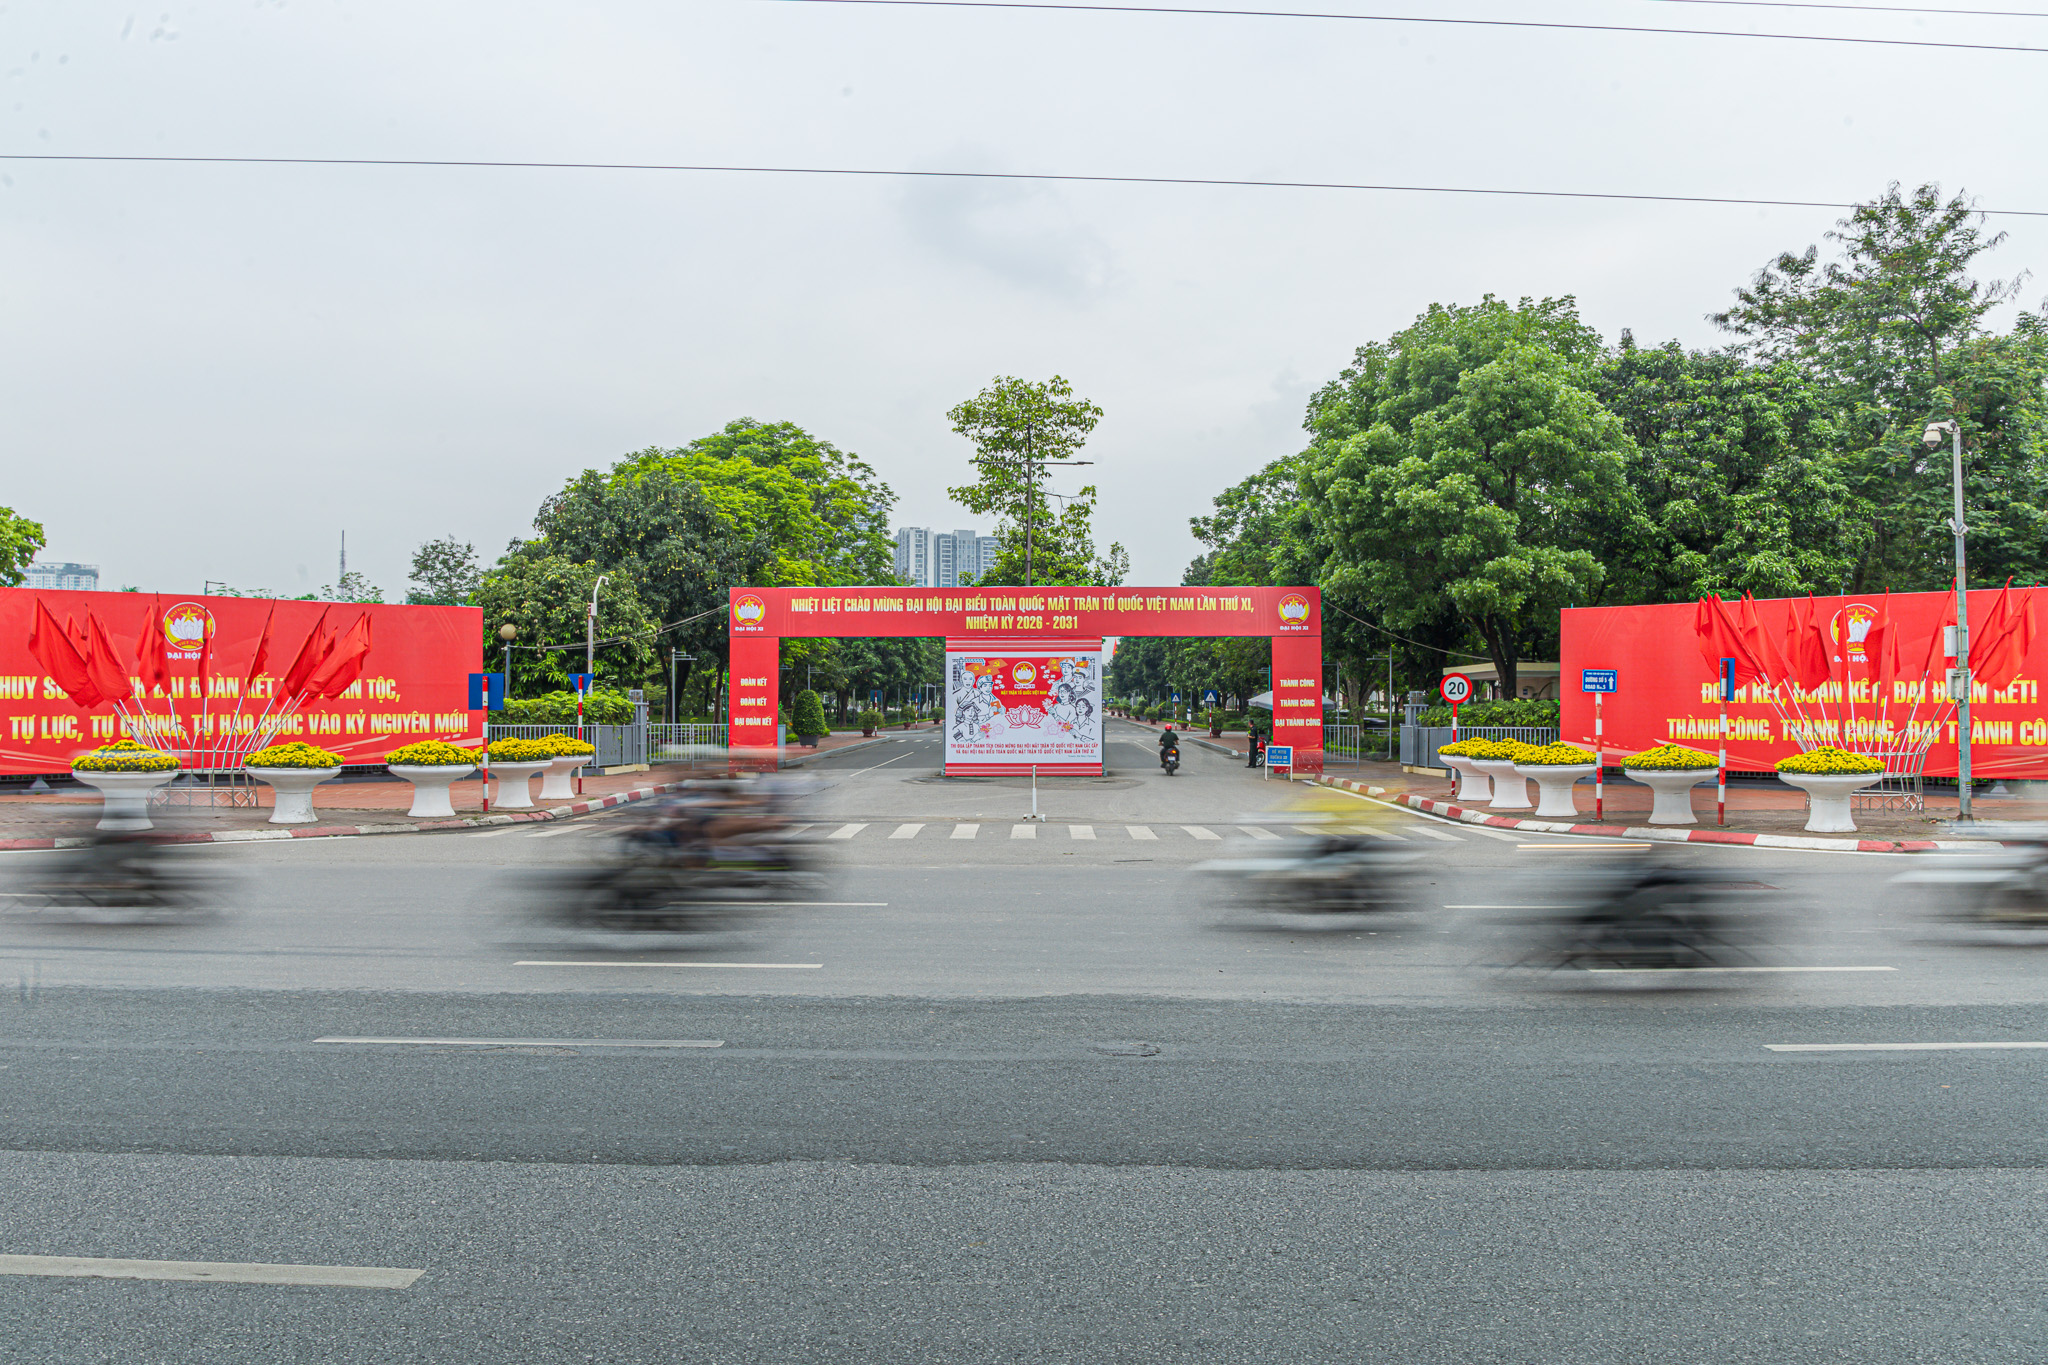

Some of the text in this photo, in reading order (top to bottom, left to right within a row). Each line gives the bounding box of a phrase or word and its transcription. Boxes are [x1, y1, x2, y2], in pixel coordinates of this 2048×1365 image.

[791, 593, 1254, 614] NHIỆT LIỆT CHÀO MỪNG ĐẠI HỘI ĐẠI BIỂU TOÀN QUỐC MẶT TRẬN TỔ QUỐC VIỆT NAM LẦN THỨ XI,
[966, 614, 998, 632] NHIỆM
[1001, 614, 1014, 629] KỲ
[1017, 616, 1043, 629] 2026
[1053, 616, 1078, 629] 2031
[166, 652, 182, 660] ĐẠI
[184, 651, 201, 660] HỘI
[1853, 654, 1868, 662] HỘ
[740, 676, 767, 686] ĐOÀN KẾT
[1280, 678, 1315, 687] THÀNH CÔNG
[0, 676, 38, 699] HUY
[366, 676, 401, 703] TỘC,
[1448, 682, 1465, 695] 20
[1893, 681, 1926, 707] ĐẠI
[740, 696, 767, 706] ĐOÀN KẾT
[1280, 698, 1315, 707] THÀNH CÔNG
[9, 714, 36, 744] TỰ
[41, 714, 83, 743] LỰC,
[90, 714, 115, 743] TỰ
[191, 713, 215, 741] TỰ
[220, 710, 254, 735] HÀO
[308, 710, 341, 735] VÀO
[346, 709, 366, 734] KỶ
[371, 710, 430, 734] NGUYÊN
[435, 709, 468, 733] MỚI!
[734, 716, 772, 727] ĐẠI ĐOÀN KẾT
[1275, 717, 1321, 727] ĐẠI THÀNH CÔNG
[1667, 715, 1719, 740] THÀNH
[1726, 716, 1775, 744] CÔNG,
[1946, 716, 2012, 745] TÀNH
[2020, 718, 2048, 746] CÔ
